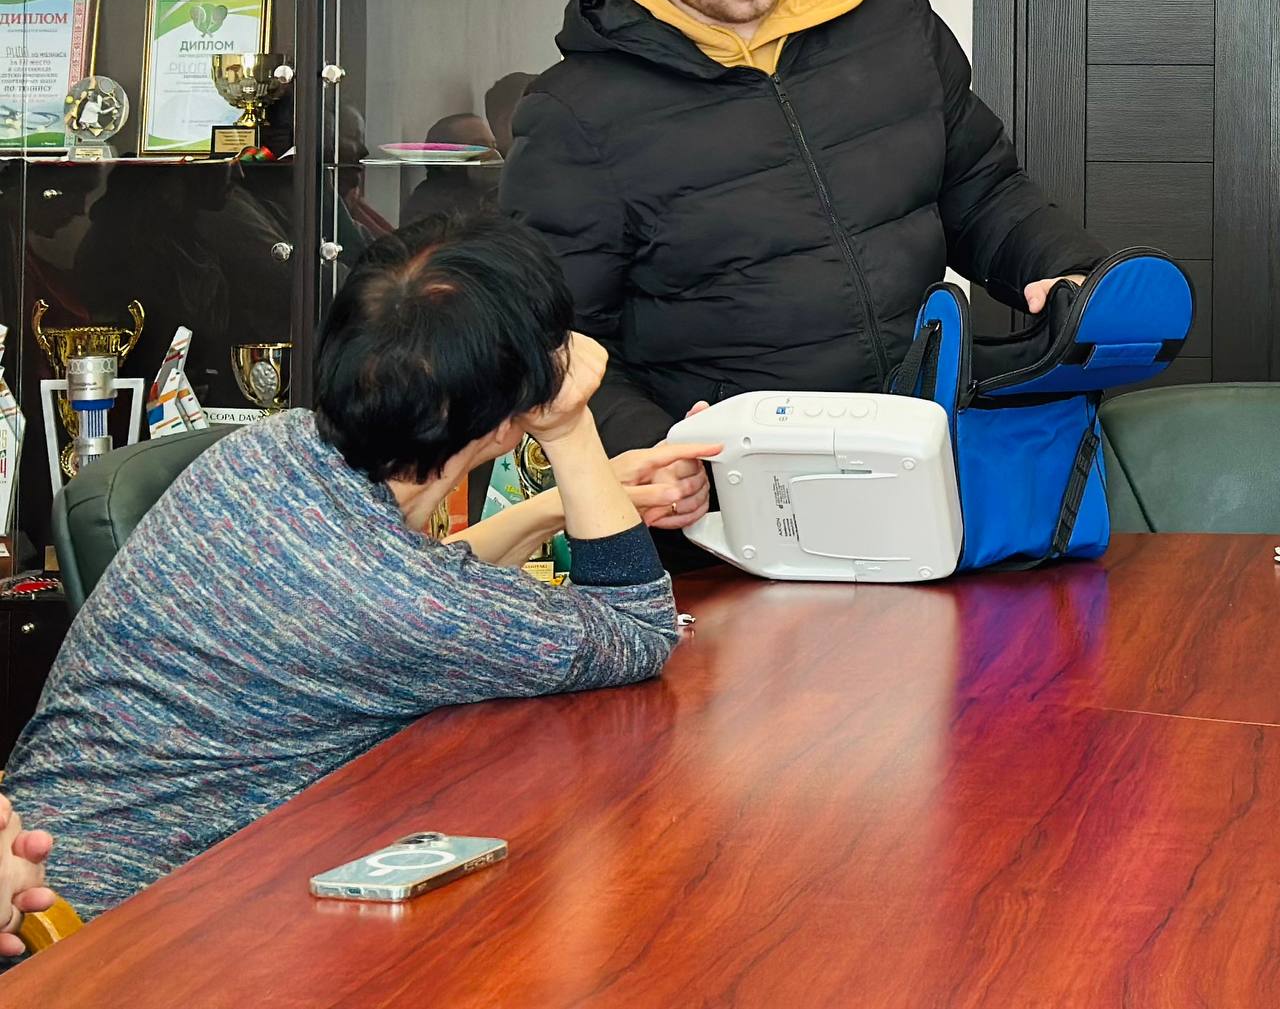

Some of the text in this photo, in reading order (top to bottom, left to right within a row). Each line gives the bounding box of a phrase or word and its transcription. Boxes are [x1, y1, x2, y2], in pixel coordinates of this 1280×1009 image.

[0, 12, 67, 26] ДИПЛОМ
[180, 40, 234, 52] ДИПЛОМ
[209, 413, 236, 421] COPA
